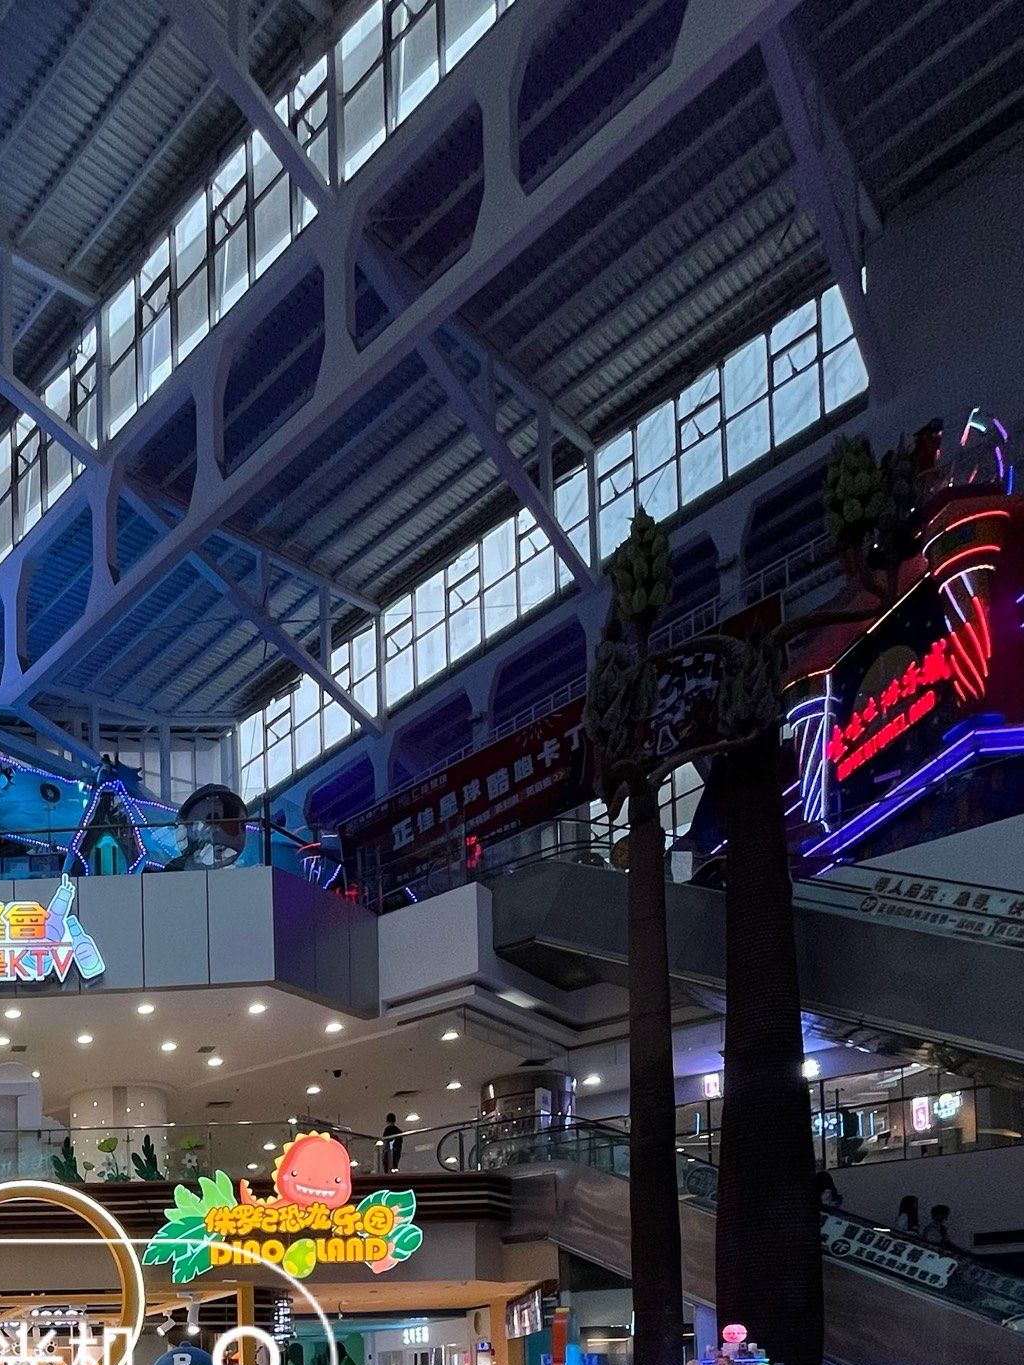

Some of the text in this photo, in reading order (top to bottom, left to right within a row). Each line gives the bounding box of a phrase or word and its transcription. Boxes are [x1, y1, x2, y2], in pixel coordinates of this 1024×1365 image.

[204, 1202, 396, 1237] 侏罗纪恐龙乐园
[210, 1237, 389, 1267] DINO LAND
